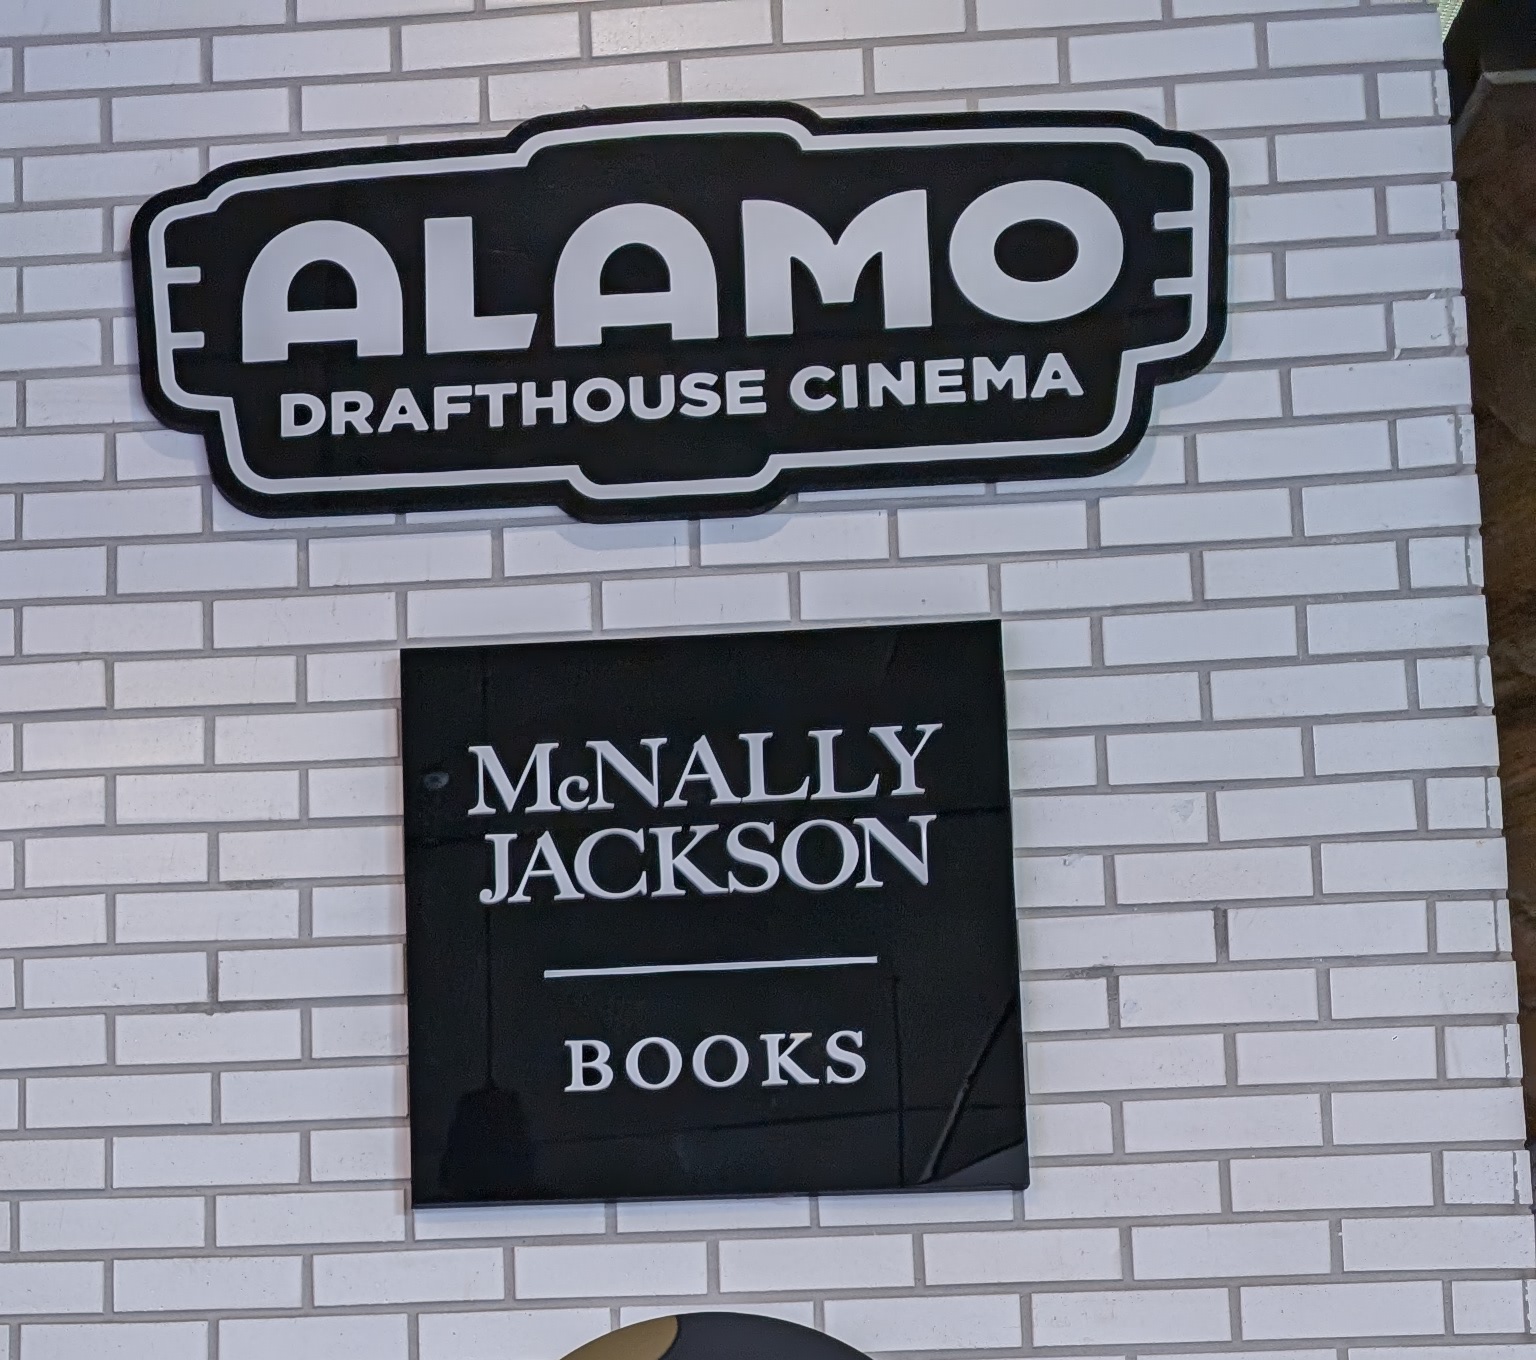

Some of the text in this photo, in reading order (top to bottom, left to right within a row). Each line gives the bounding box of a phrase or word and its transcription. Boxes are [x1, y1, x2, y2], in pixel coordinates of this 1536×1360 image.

[241, 179, 1125, 363] ALAMO
[280, 352, 1084, 438] DRAFTHOUSE CINEMA
[468, 723, 943, 815] McNALLY
[480, 815, 937, 904] JACKSON
[564, 1030, 867, 1093] BOOKS
